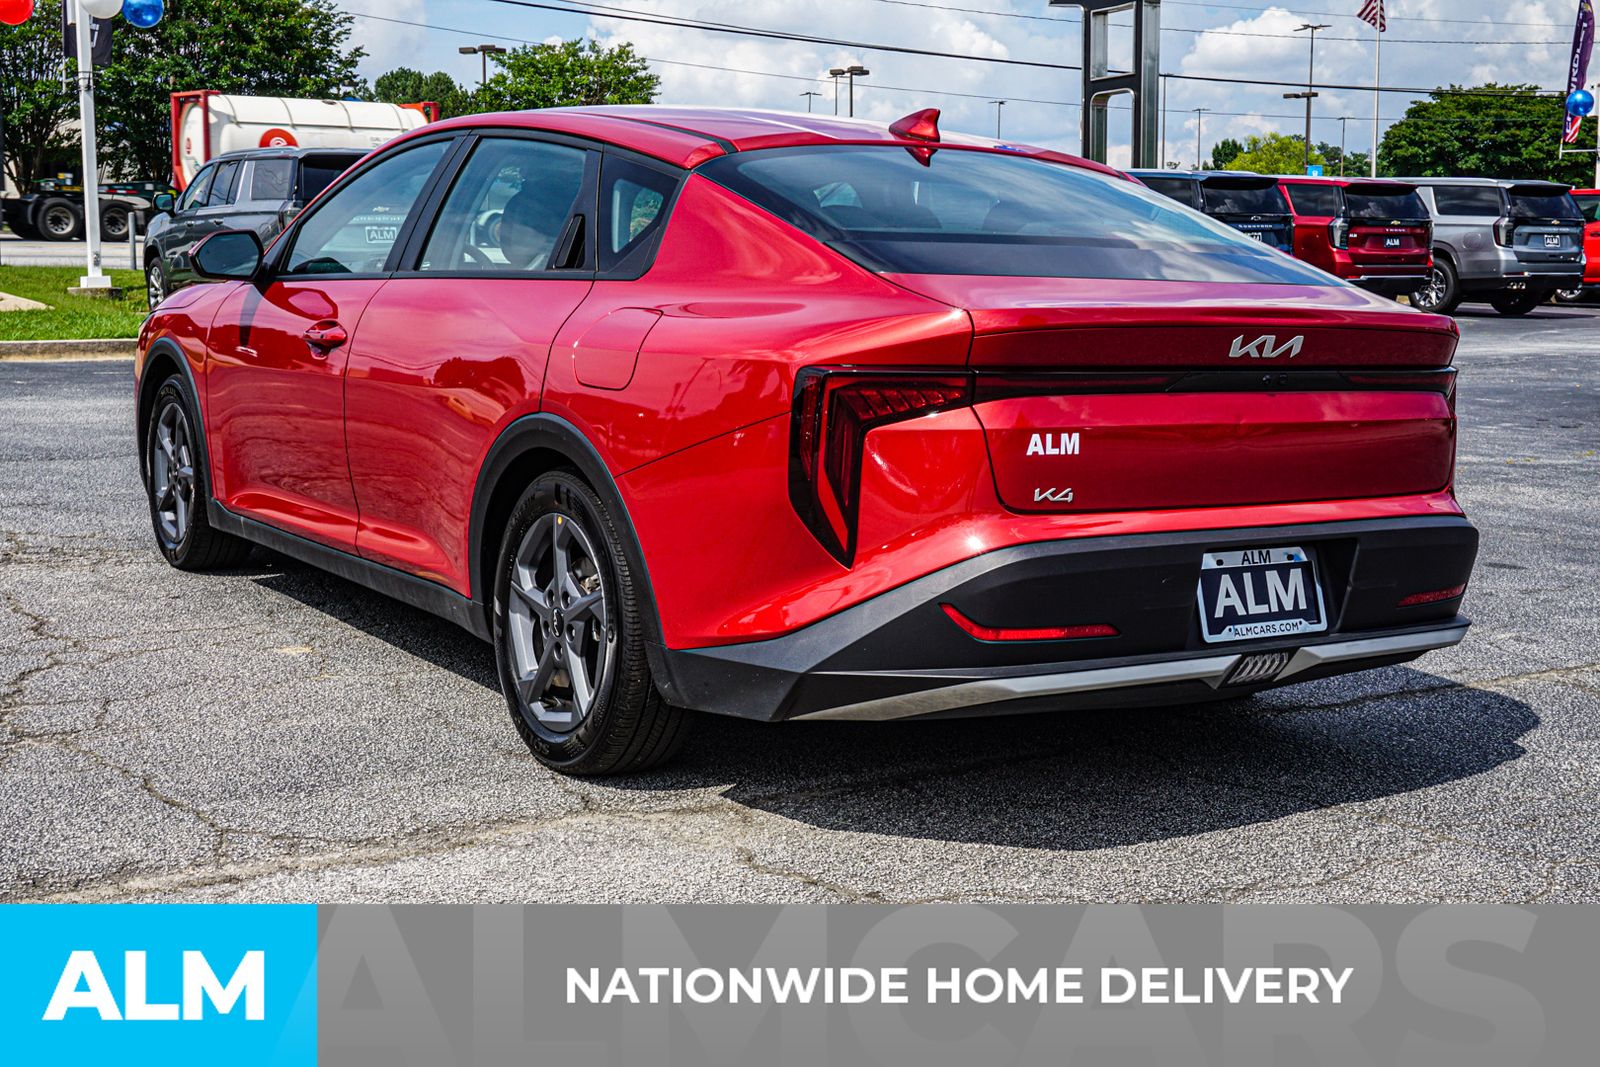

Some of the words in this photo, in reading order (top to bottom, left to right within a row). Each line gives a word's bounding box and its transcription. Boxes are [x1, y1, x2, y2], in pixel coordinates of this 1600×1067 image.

[369, 230, 394, 240] ALM
[1386, 238, 1400, 246] ALM
[1026, 432, 1080, 456] ALM
[1034, 487, 1074, 503] K4
[1241, 549, 1272, 566] ALM
[1214, 567, 1308, 619] ALM
[1234, 621, 1300, 638] ALMCARS.COM
